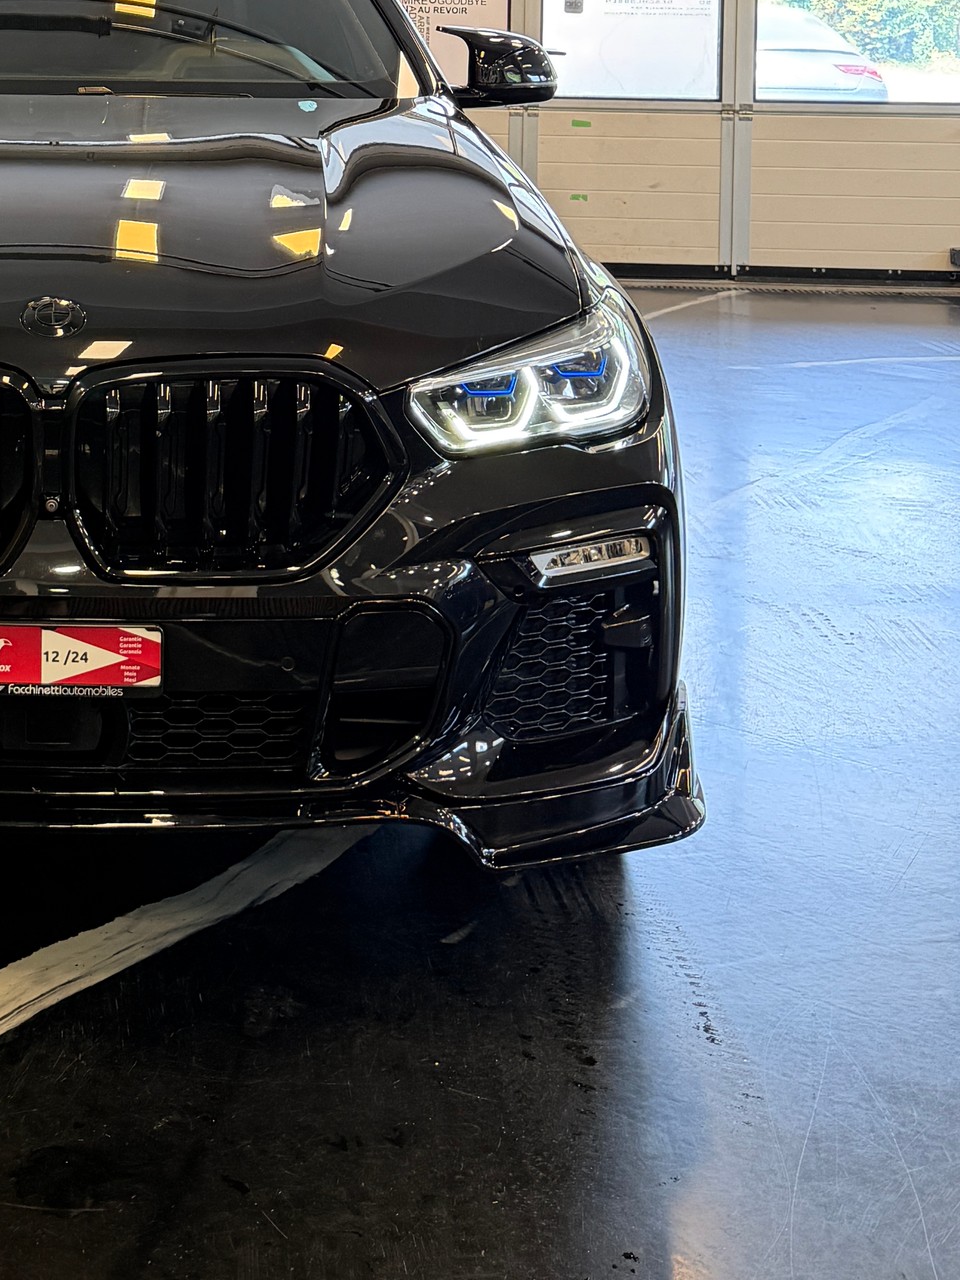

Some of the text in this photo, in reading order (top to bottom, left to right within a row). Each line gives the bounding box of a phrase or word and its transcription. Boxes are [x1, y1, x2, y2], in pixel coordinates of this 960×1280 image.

[417, 6, 431, 14] AU
[433, 6, 468, 15] REVOIR
[42, 650, 60, 663] 12
